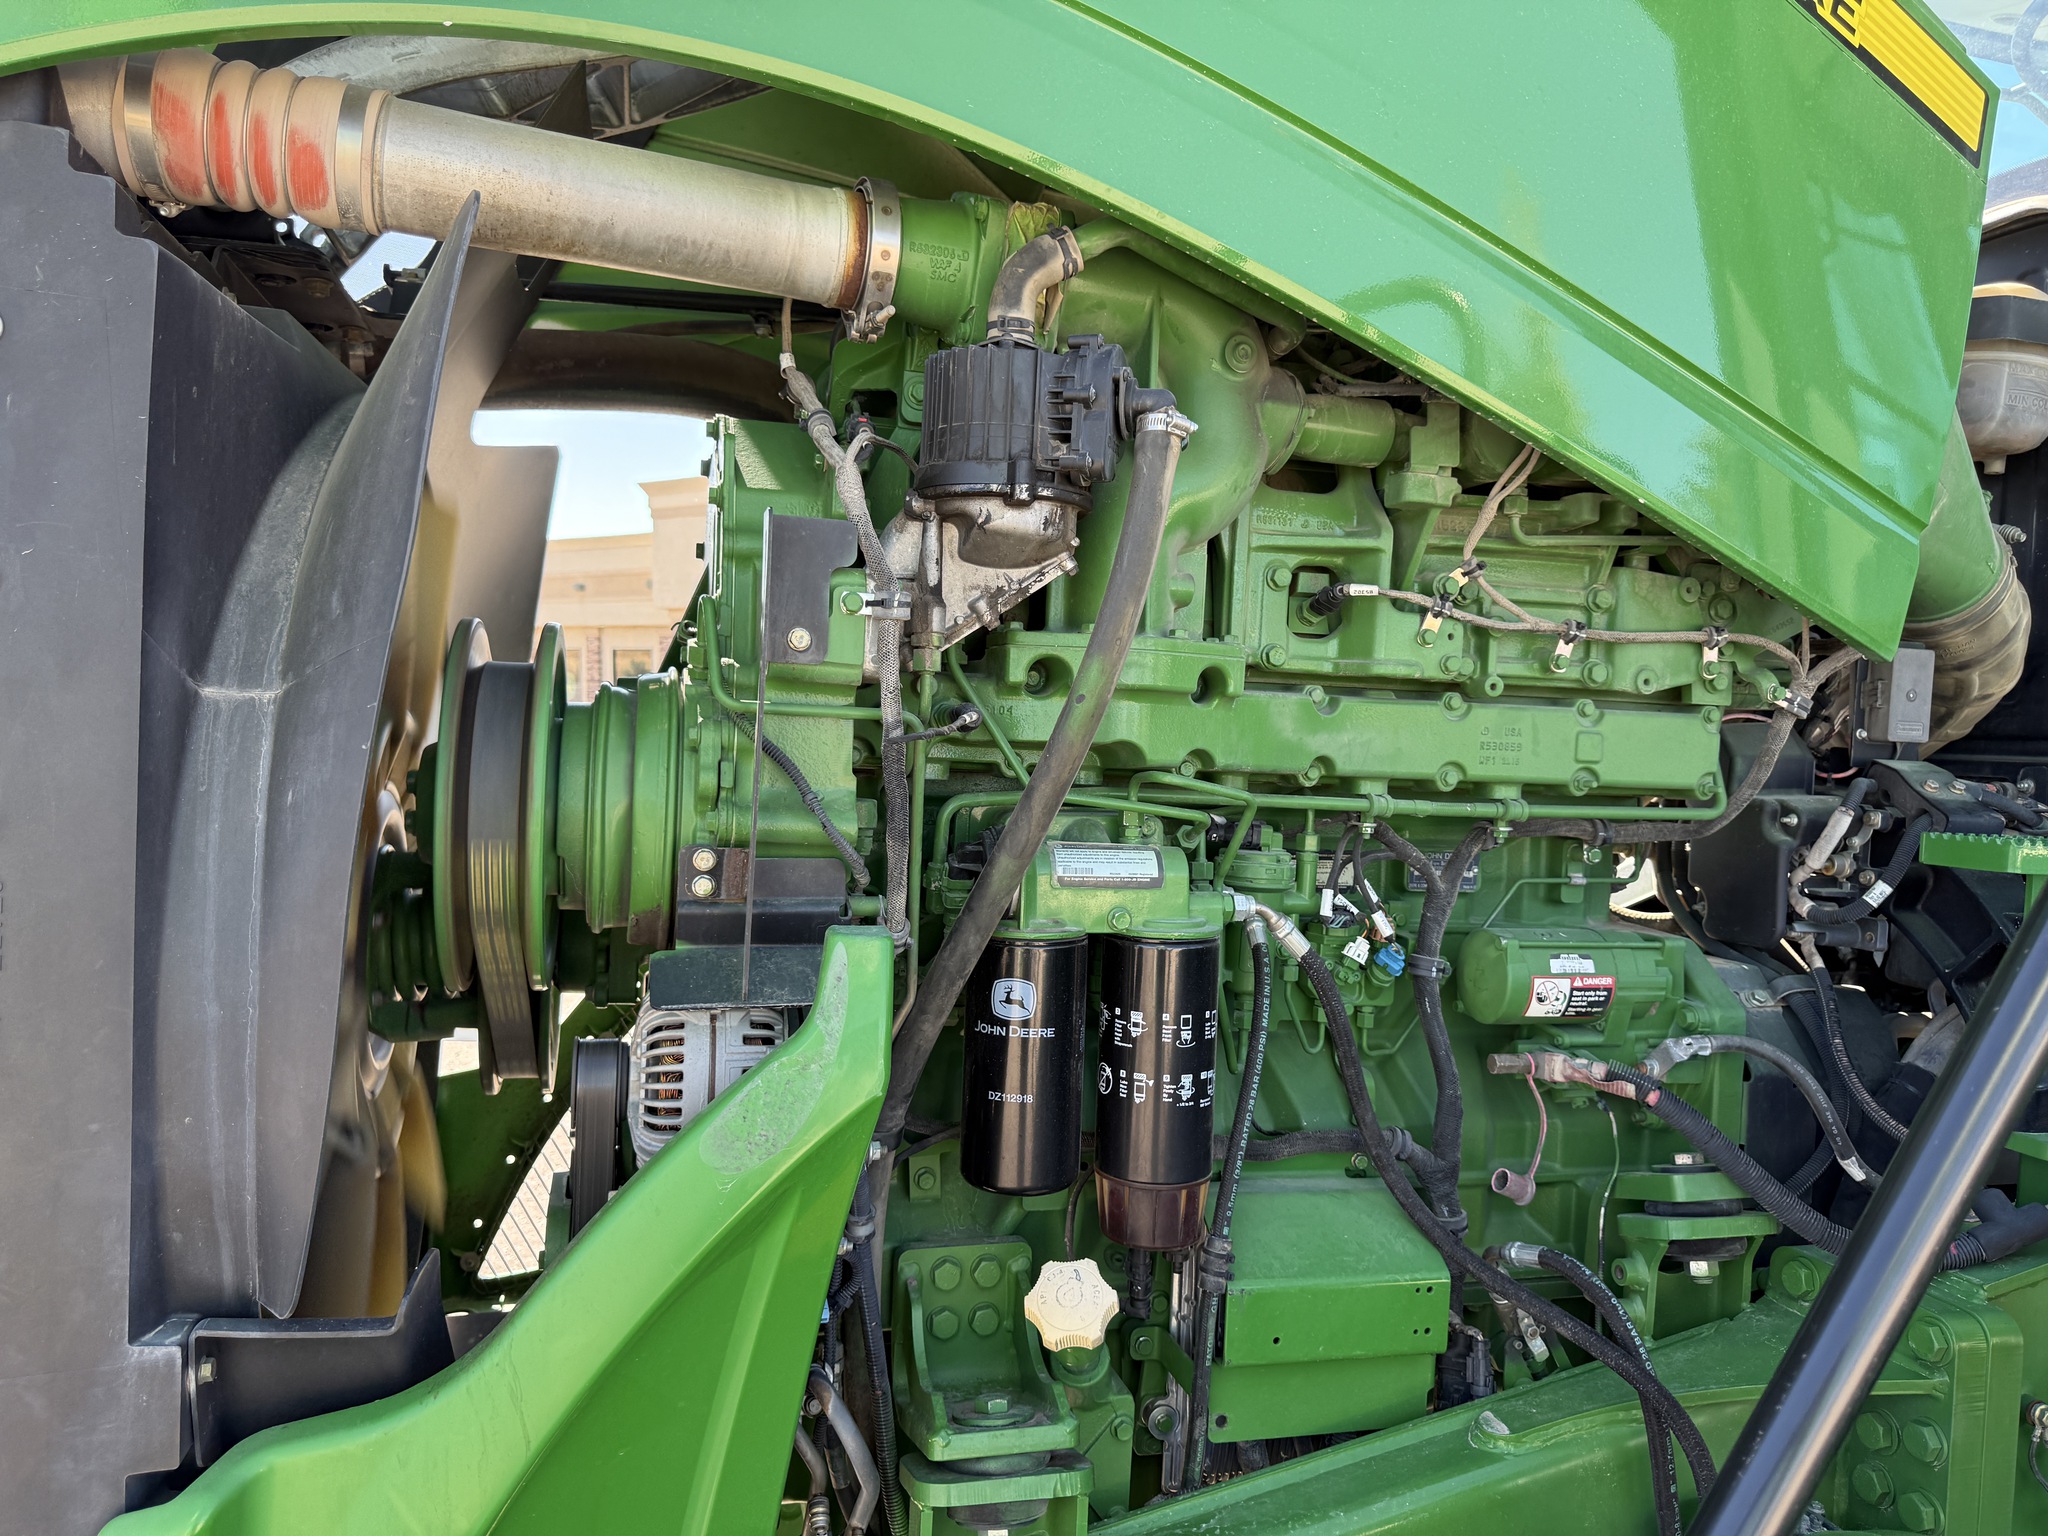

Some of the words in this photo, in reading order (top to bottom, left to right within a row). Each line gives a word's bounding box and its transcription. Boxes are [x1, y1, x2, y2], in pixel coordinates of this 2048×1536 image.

[2008, 394, 2028, 406] MIN
[1504, 728, 1522, 737] USA
[1265, 985, 1270, 996] IN
[1262, 996, 1270, 1027] MADE
[974, 1020, 1006, 1036] JOHN
[1009, 1026, 1055, 1037] DEERE
[1258, 1030, 1267, 1052] PSI)
[1254, 1052, 1263, 1074] (400
[1251, 1074, 1260, 1099] BAR
[988, 1090, 1033, 1103] DZ112918
[1249, 1100, 1255, 1113] 28
[1832, 1126, 1838, 1134] GA
[1626, 1322, 1642, 1346] BAR
[1638, 1347, 1649, 1360] 28
